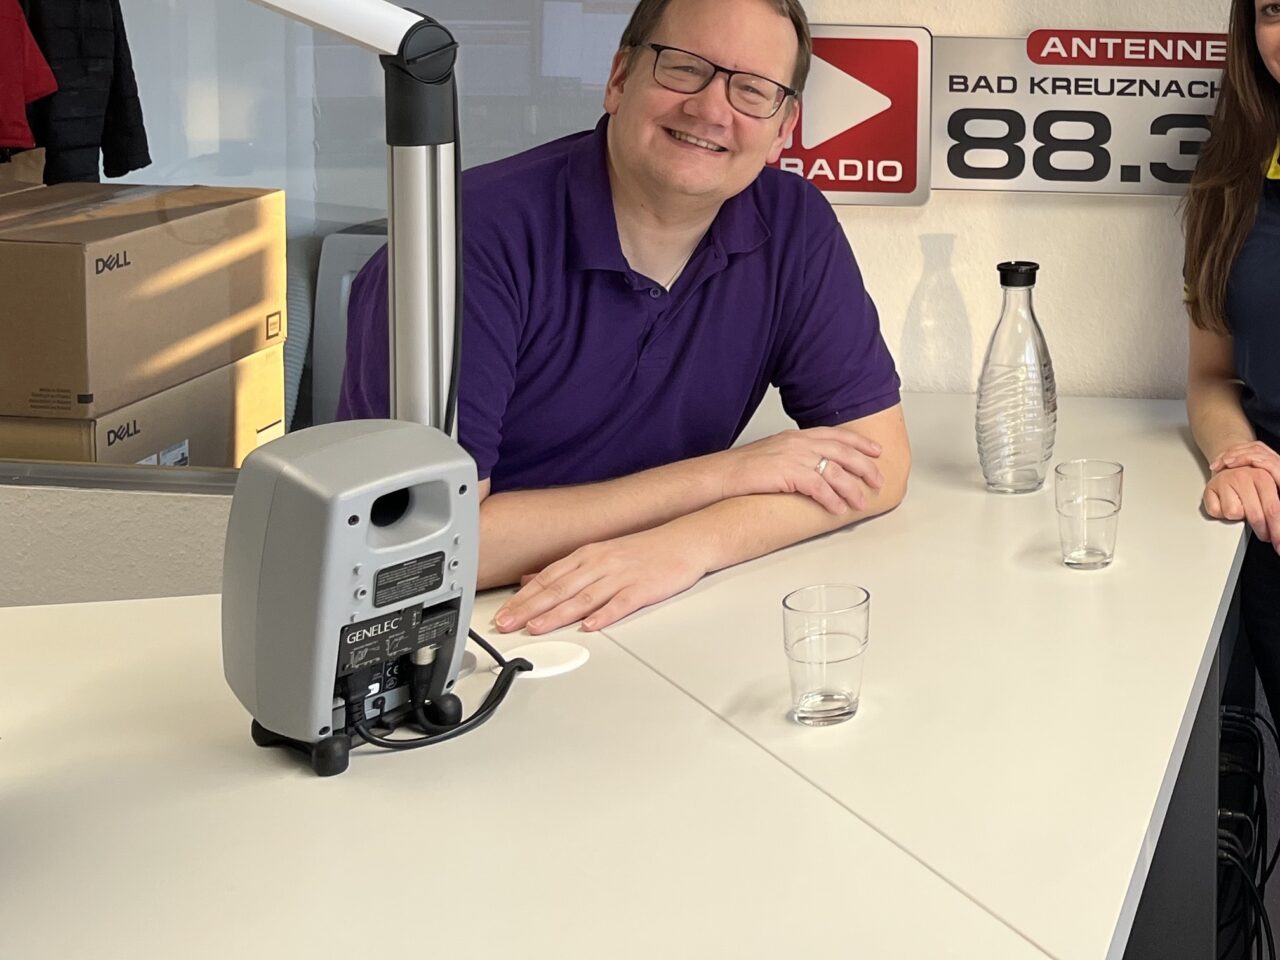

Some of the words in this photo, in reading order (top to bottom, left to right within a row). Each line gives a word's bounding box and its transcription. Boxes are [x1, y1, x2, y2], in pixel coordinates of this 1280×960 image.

[1040, 36, 1227, 63] ANTENNE
[949, 74, 1017, 94] BAD
[947, 108, 1214, 184] 88.3
[780, 157, 903, 182] RADIO
[95, 251, 132, 275] DELL
[107, 420, 141, 447] DELL
[346, 617, 400, 644] GENELEC
